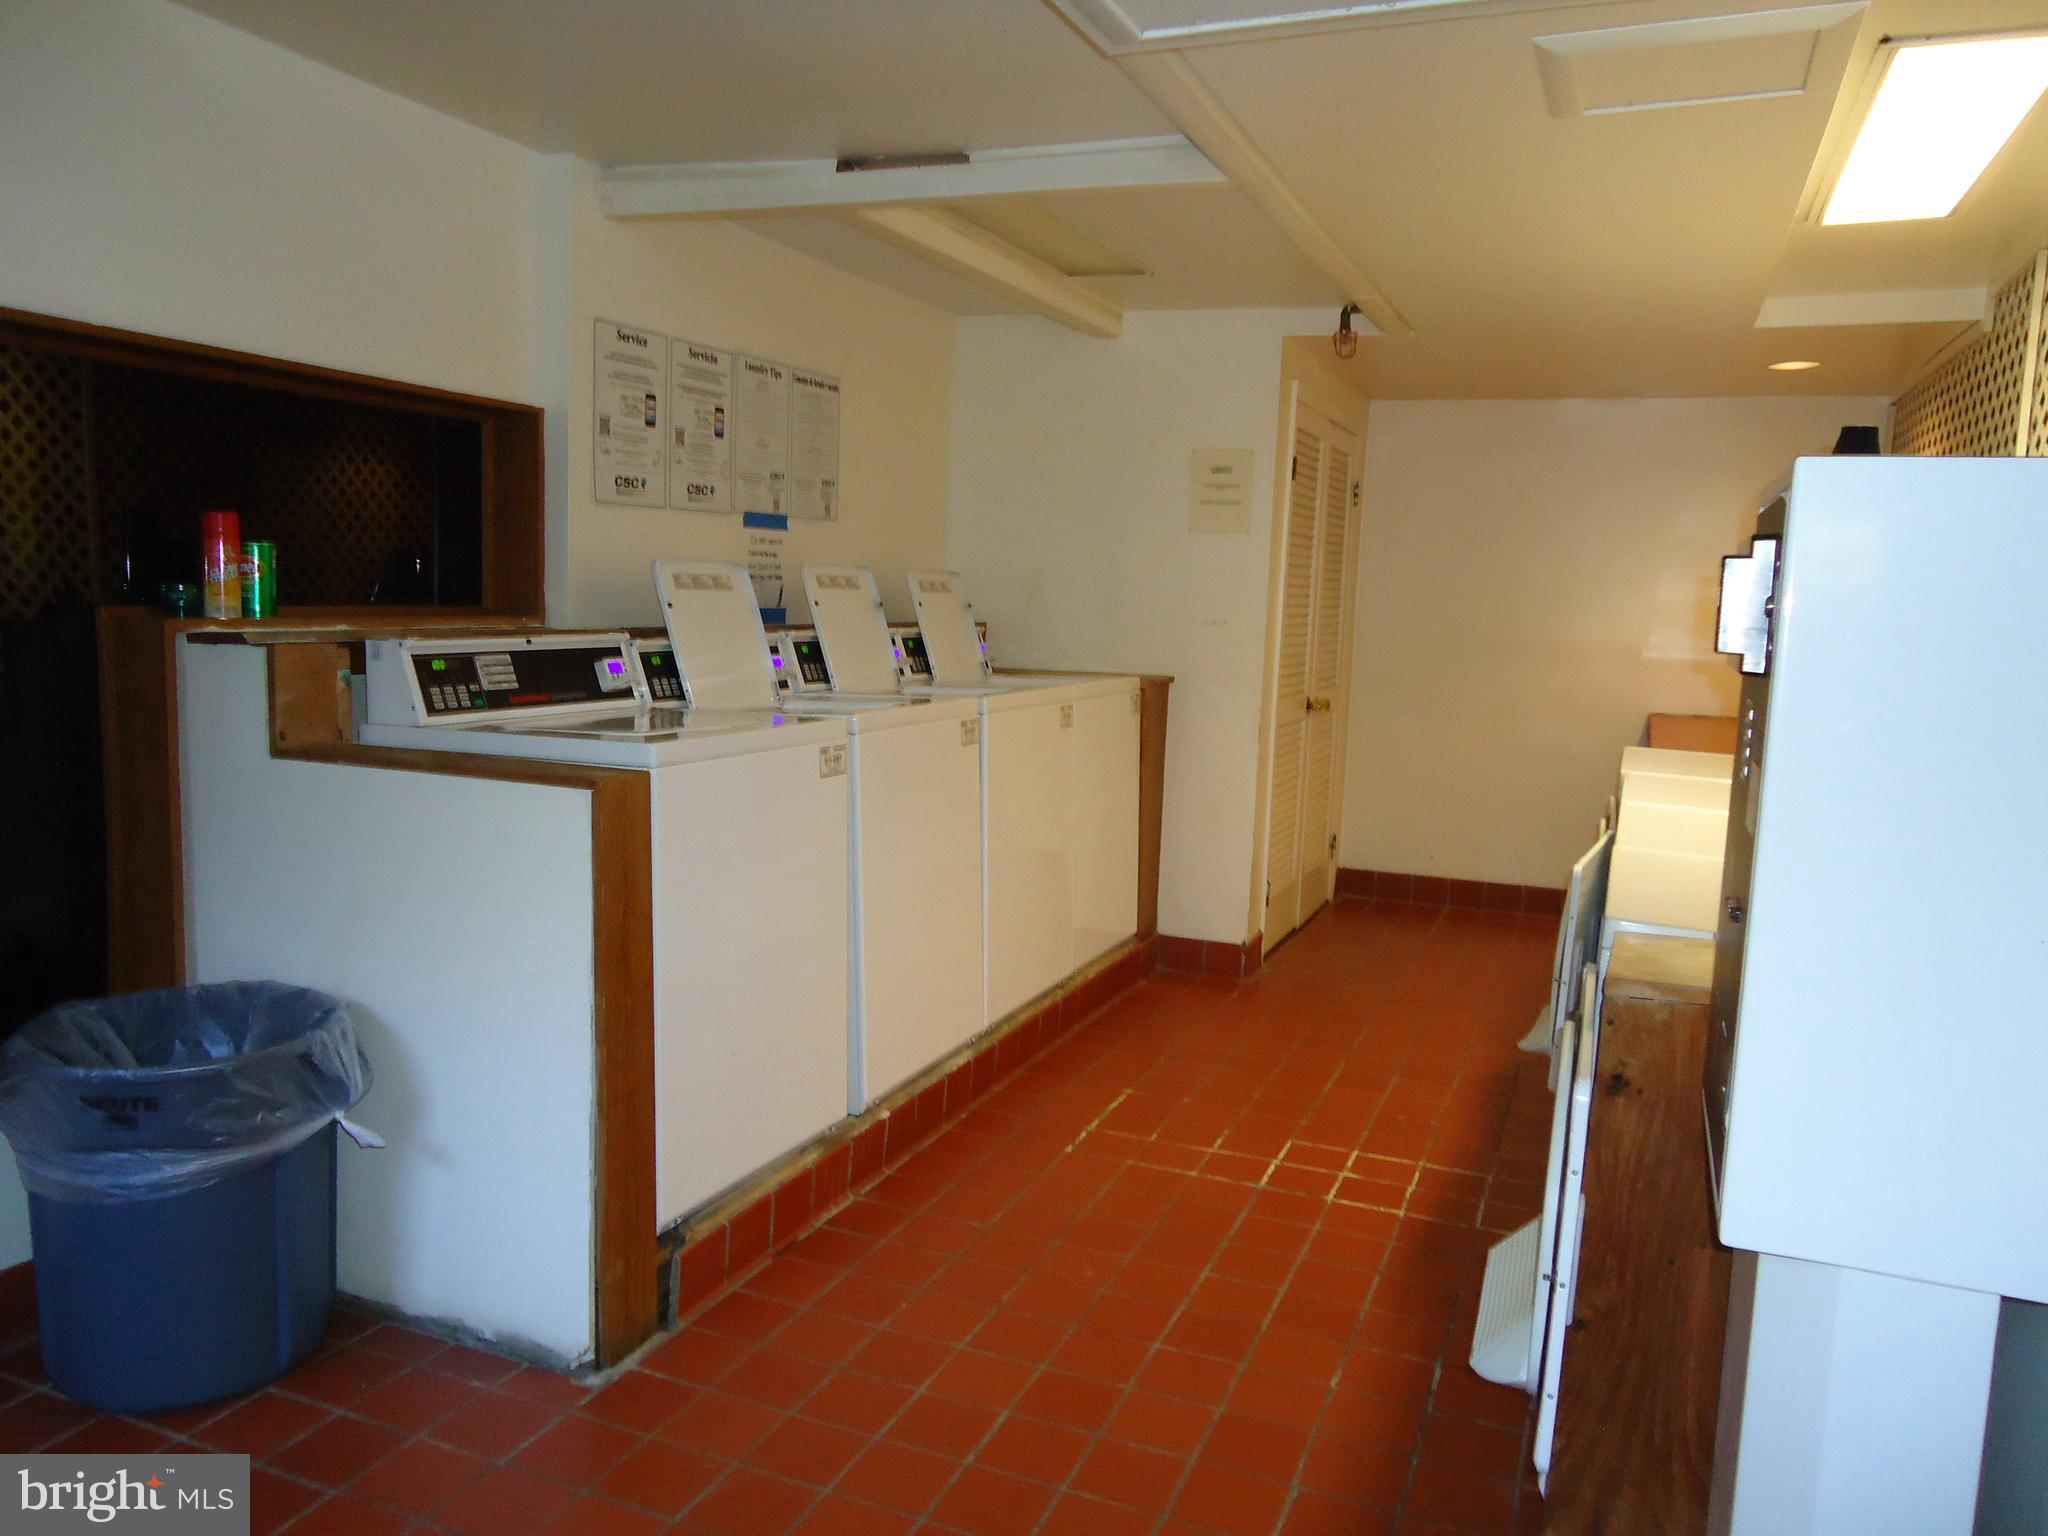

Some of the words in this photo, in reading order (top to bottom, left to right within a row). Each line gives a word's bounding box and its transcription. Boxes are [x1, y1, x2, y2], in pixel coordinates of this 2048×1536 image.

[616, 328, 648, 348] Service
[688, 346, 719, 366] Servicio
[615, 475, 640, 489] CSC
[687, 484, 710, 496] CSC
